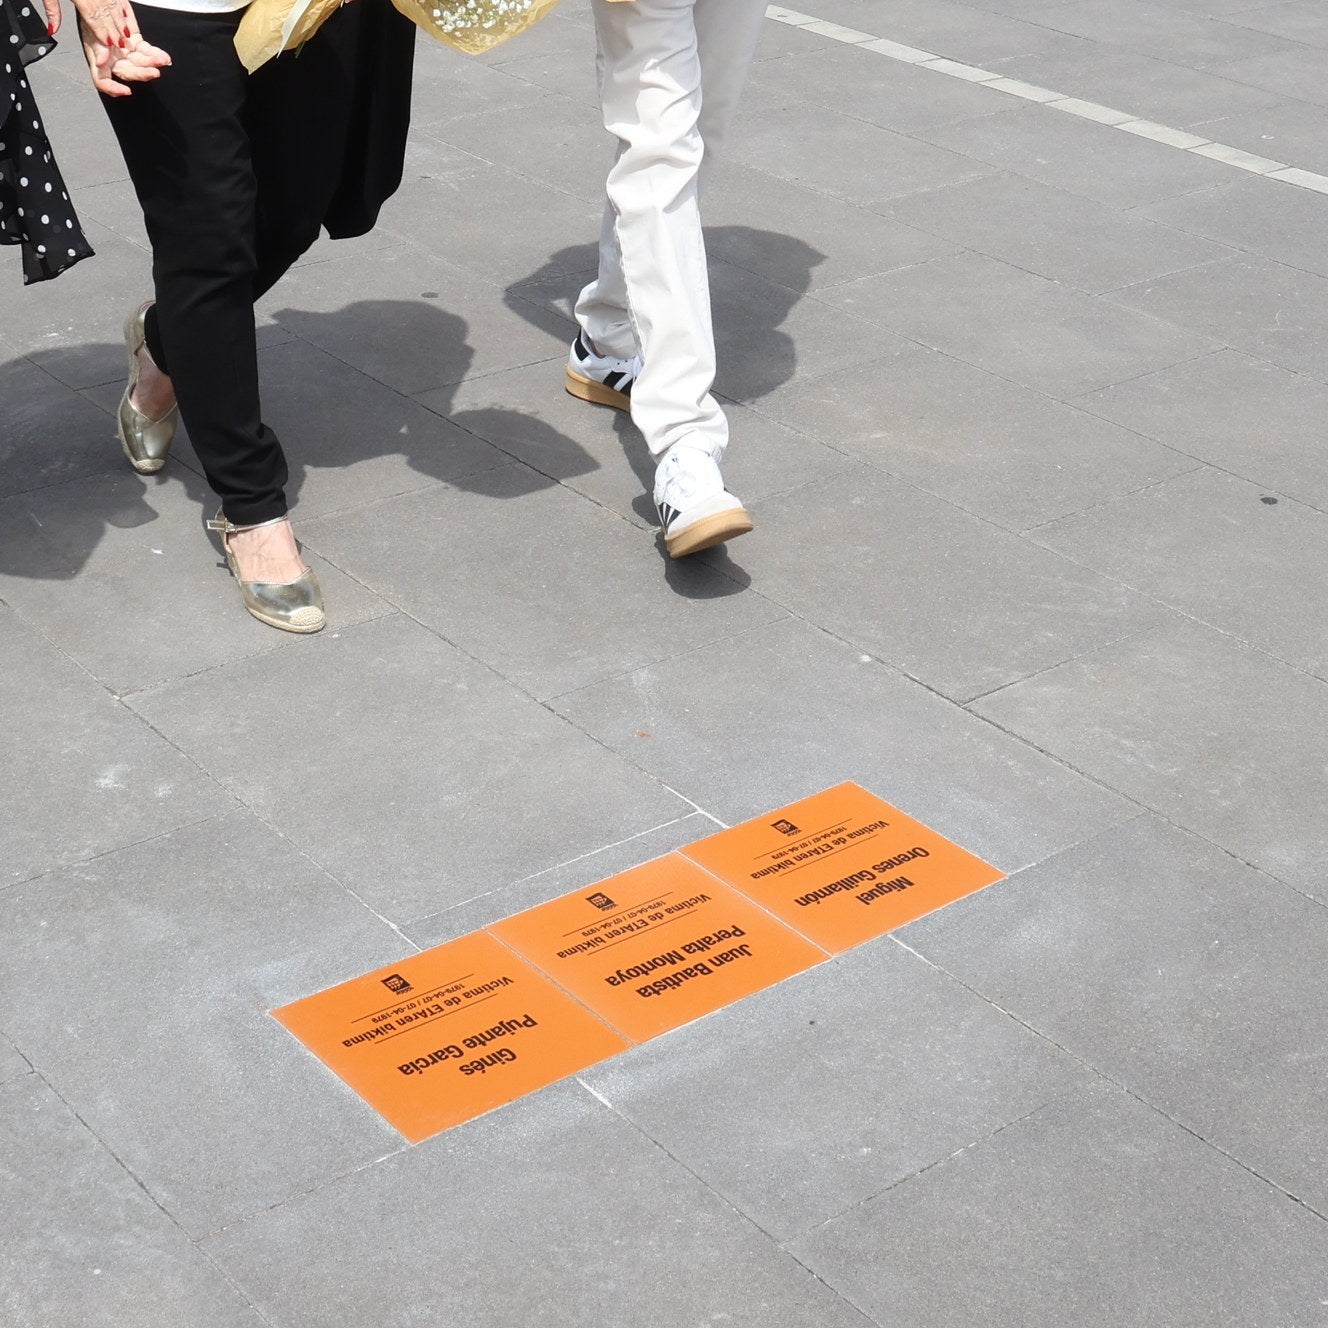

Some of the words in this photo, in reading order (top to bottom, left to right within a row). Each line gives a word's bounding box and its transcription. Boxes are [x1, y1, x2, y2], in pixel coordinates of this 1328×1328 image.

[832, 836, 846, 846] de
[795, 844, 833, 861] ETAren
[872, 847, 929, 873] Orenes
[751, 860, 795, 878] biktima
[794, 870, 876, 906] Guillamón
[856, 877, 914, 905] Miguel
[628, 901, 665, 918] 1979-04-07
[648, 912, 664, 922] de
[582, 918, 622, 936] 07-04-1979
[605, 919, 649, 938] ETAren
[557, 937, 605, 958] biktima
[681, 925, 746, 954] Peralta
[708, 944, 752, 966] Juan
[605, 950, 685, 987] Montoya
[636, 963, 713, 997] Bautista
[422, 983, 466, 1004] 1979-04-07
[443, 996, 461, 1008] de
[372, 1003, 416, 1023] 07-04-1979
[396, 1004, 444, 1025] ETAren
[342, 1023, 395, 1047] biktima
[463, 1014, 537, 1048] Pujante
[398, 1045, 464, 1075] García
[459, 1049, 516, 1075] Ginés
